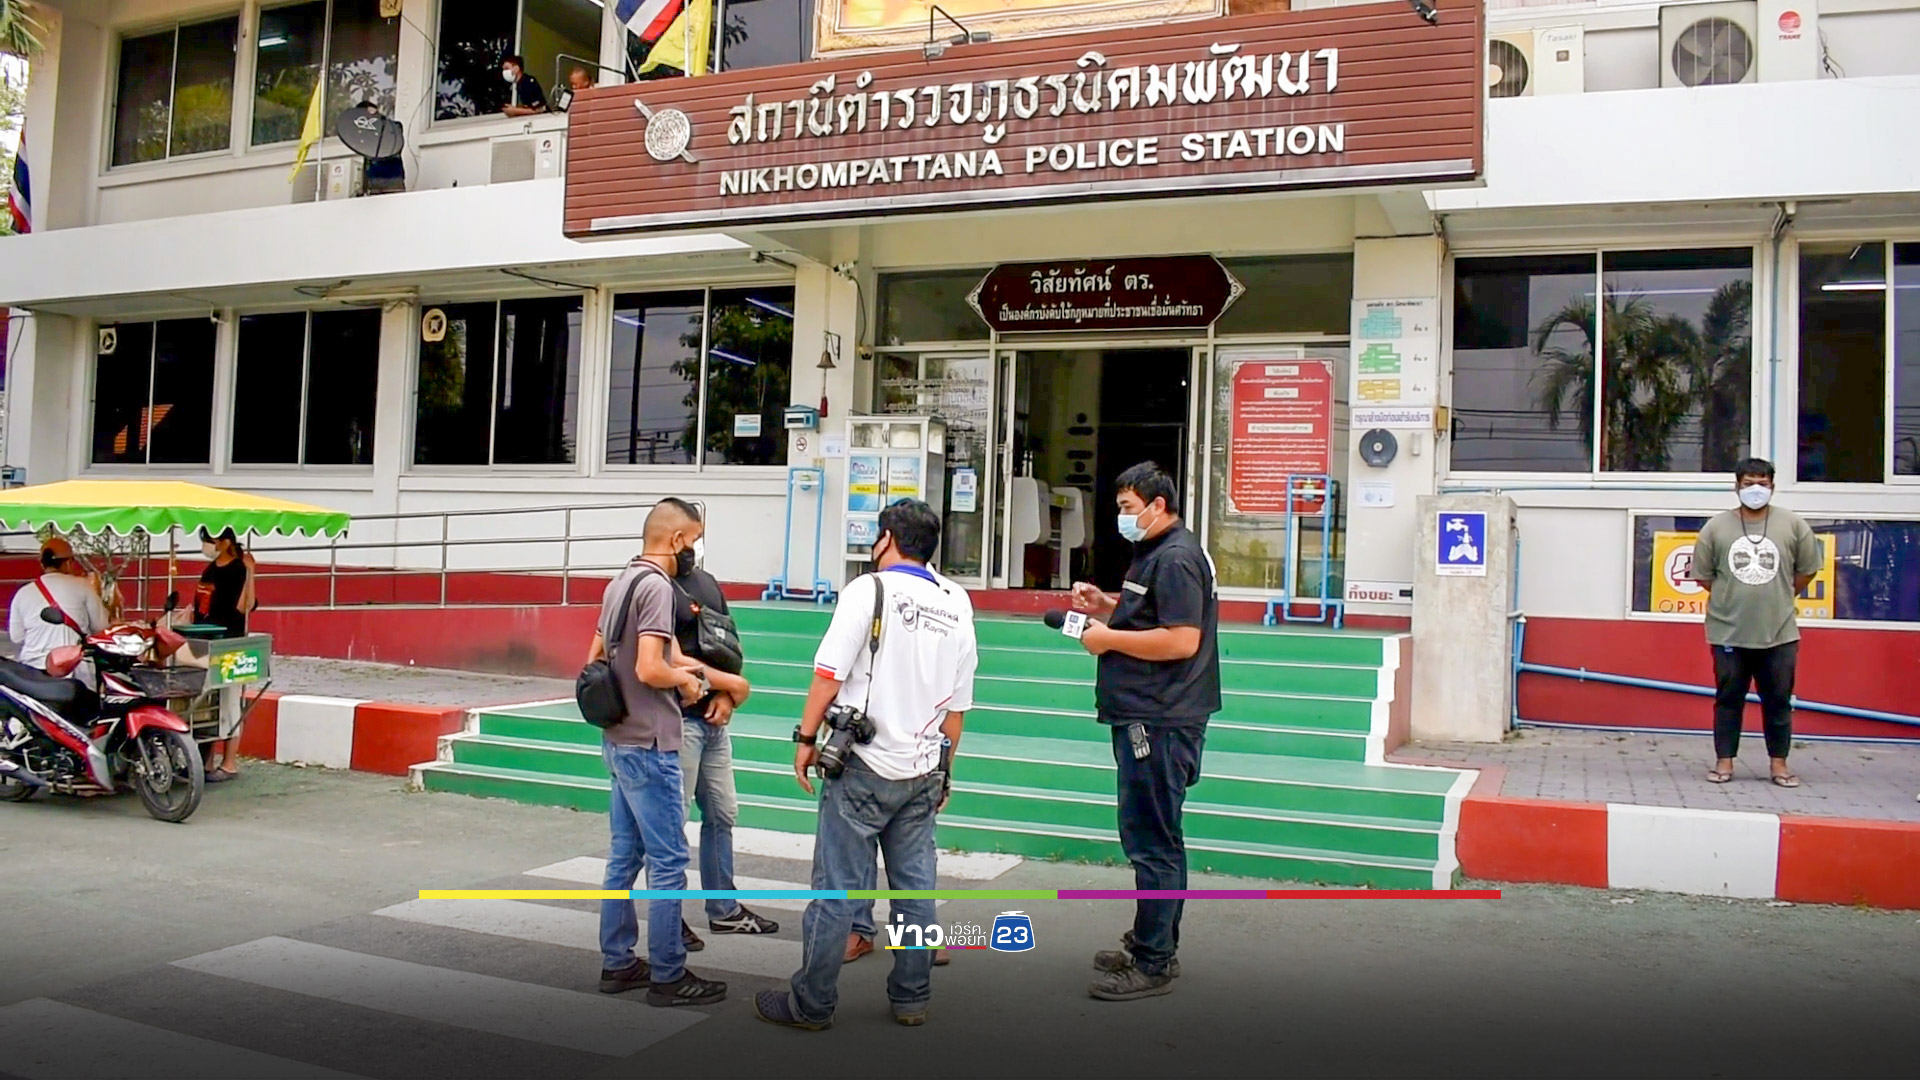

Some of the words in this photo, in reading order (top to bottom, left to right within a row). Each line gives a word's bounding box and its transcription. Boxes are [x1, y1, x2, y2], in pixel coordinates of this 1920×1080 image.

[727, 42, 1339, 145] สถานีตำรวจภูธรนิคมพัฒนา
[719, 149, 1004, 196] NIKHOMPATTANA
[1025, 136, 1159, 174] POLICE
[1180, 123, 1345, 163] STATION
[1030, 265, 1116, 294] วิสัยทัศน์
[1124, 273, 1154, 292] ตร.
[1348, 584, 1394, 601] ทิ้งขยะ
